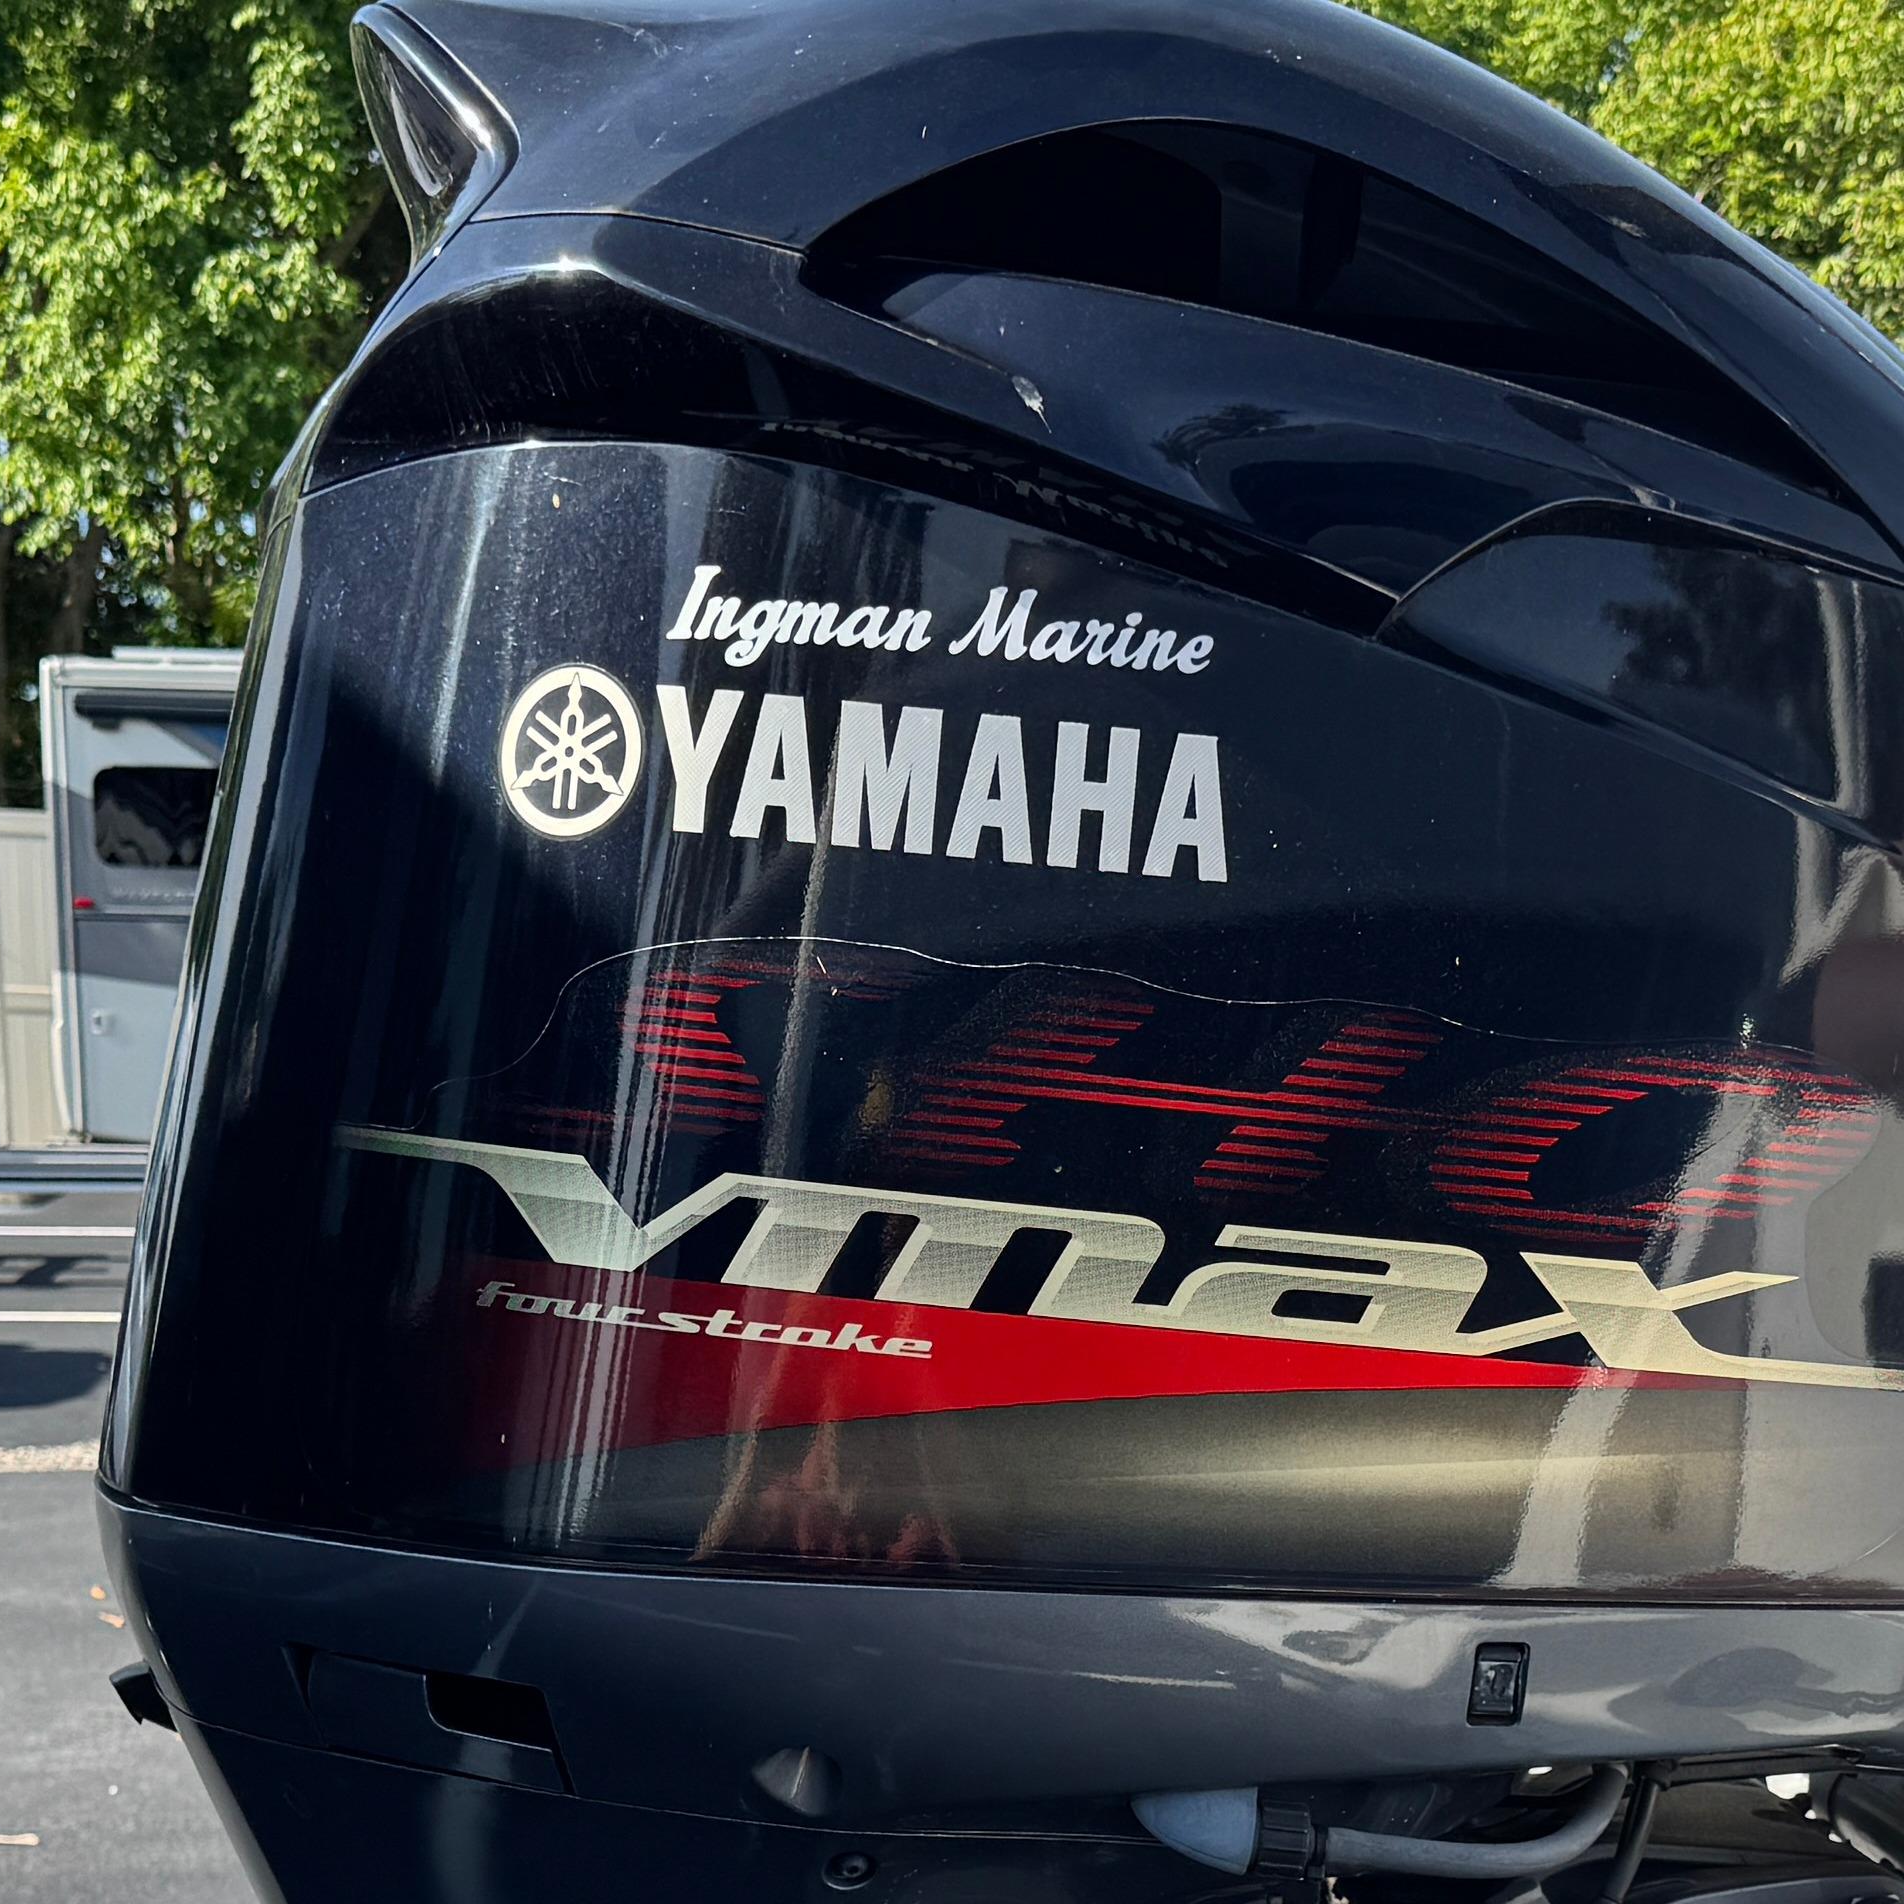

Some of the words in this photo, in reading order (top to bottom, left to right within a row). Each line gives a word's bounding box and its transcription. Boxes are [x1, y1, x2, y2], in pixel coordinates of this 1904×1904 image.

[664, 564, 933, 668] Ingman
[948, 585, 1215, 675] Marine
[654, 684, 1228, 883] YAMAHA
